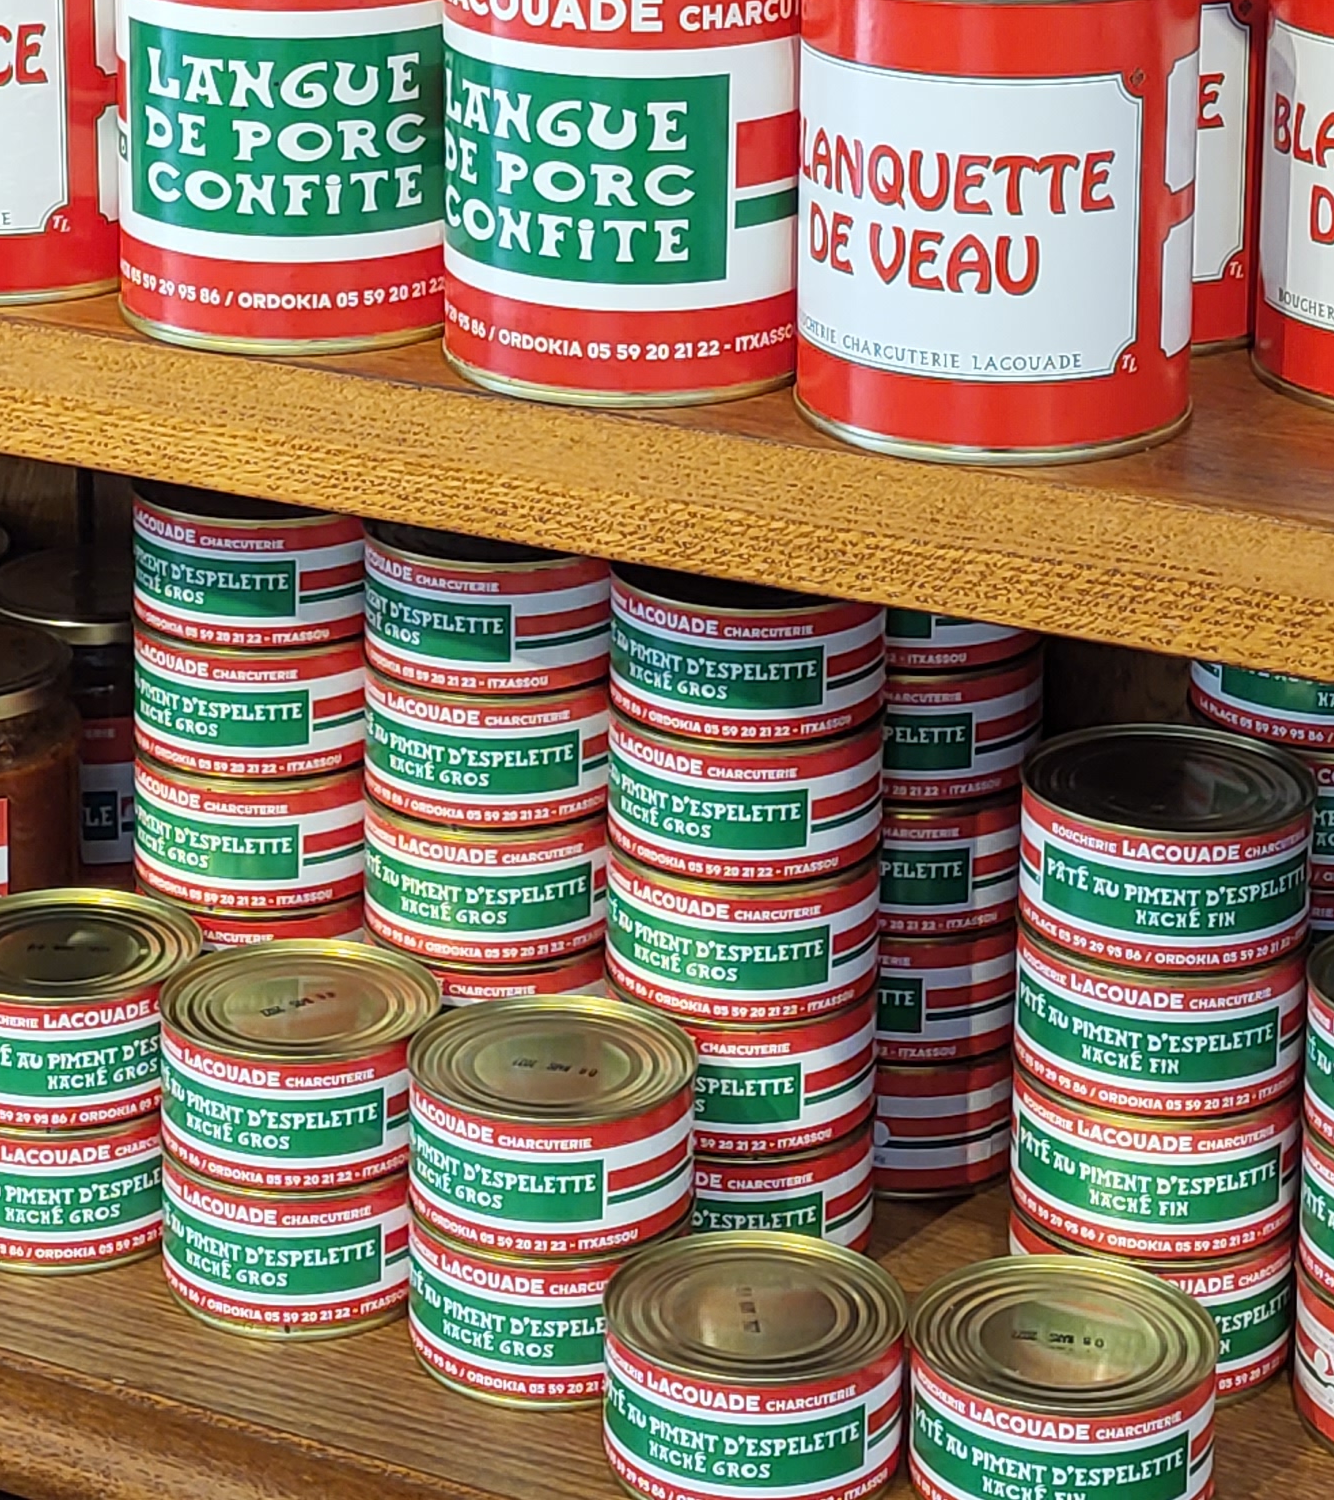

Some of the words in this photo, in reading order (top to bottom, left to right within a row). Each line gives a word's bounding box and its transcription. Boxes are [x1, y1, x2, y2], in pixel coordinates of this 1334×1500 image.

[145, 43, 422, 110] LANGUE
[445, 66, 689, 154] LANGUE
[144, 105, 208, 159] DE
[232, 113, 428, 163] PORC
[446, 135, 478, 188] DE
[496, 149, 696, 208] PORC
[799, 115, 1116, 218] LANQUETTE
[809, 201, 855, 276] DE
[869, 224, 1041, 298] VEAU
[841, 332, 961, 370] CHARCUTERIE
[972, 352, 1083, 371] LACOUADE
[629, 598, 718, 637] LACOUADE
[723, 624, 814, 639] CHARCUTERIE
[677, 680, 729, 700] GROS
[686, 659, 818, 682] D'ESPELETTE
[1051, 822, 1117, 854] BOUCHERIE
[1122, 840, 1240, 863] LACOUADE
[1047, 856, 1088, 891] PÂTÉ
[1093, 877, 1120, 898] AU
[1124, 884, 1201, 907] PIMENT
[1207, 911, 1236, 928] FIN
[1154, 952, 1219, 965] ORDOKIA
[43, 1002, 150, 1029] LACOUADE
[18, 1049, 41, 1070] AU
[46, 1045, 120, 1071] PIMENT
[113, 1059, 160, 1083] GROS
